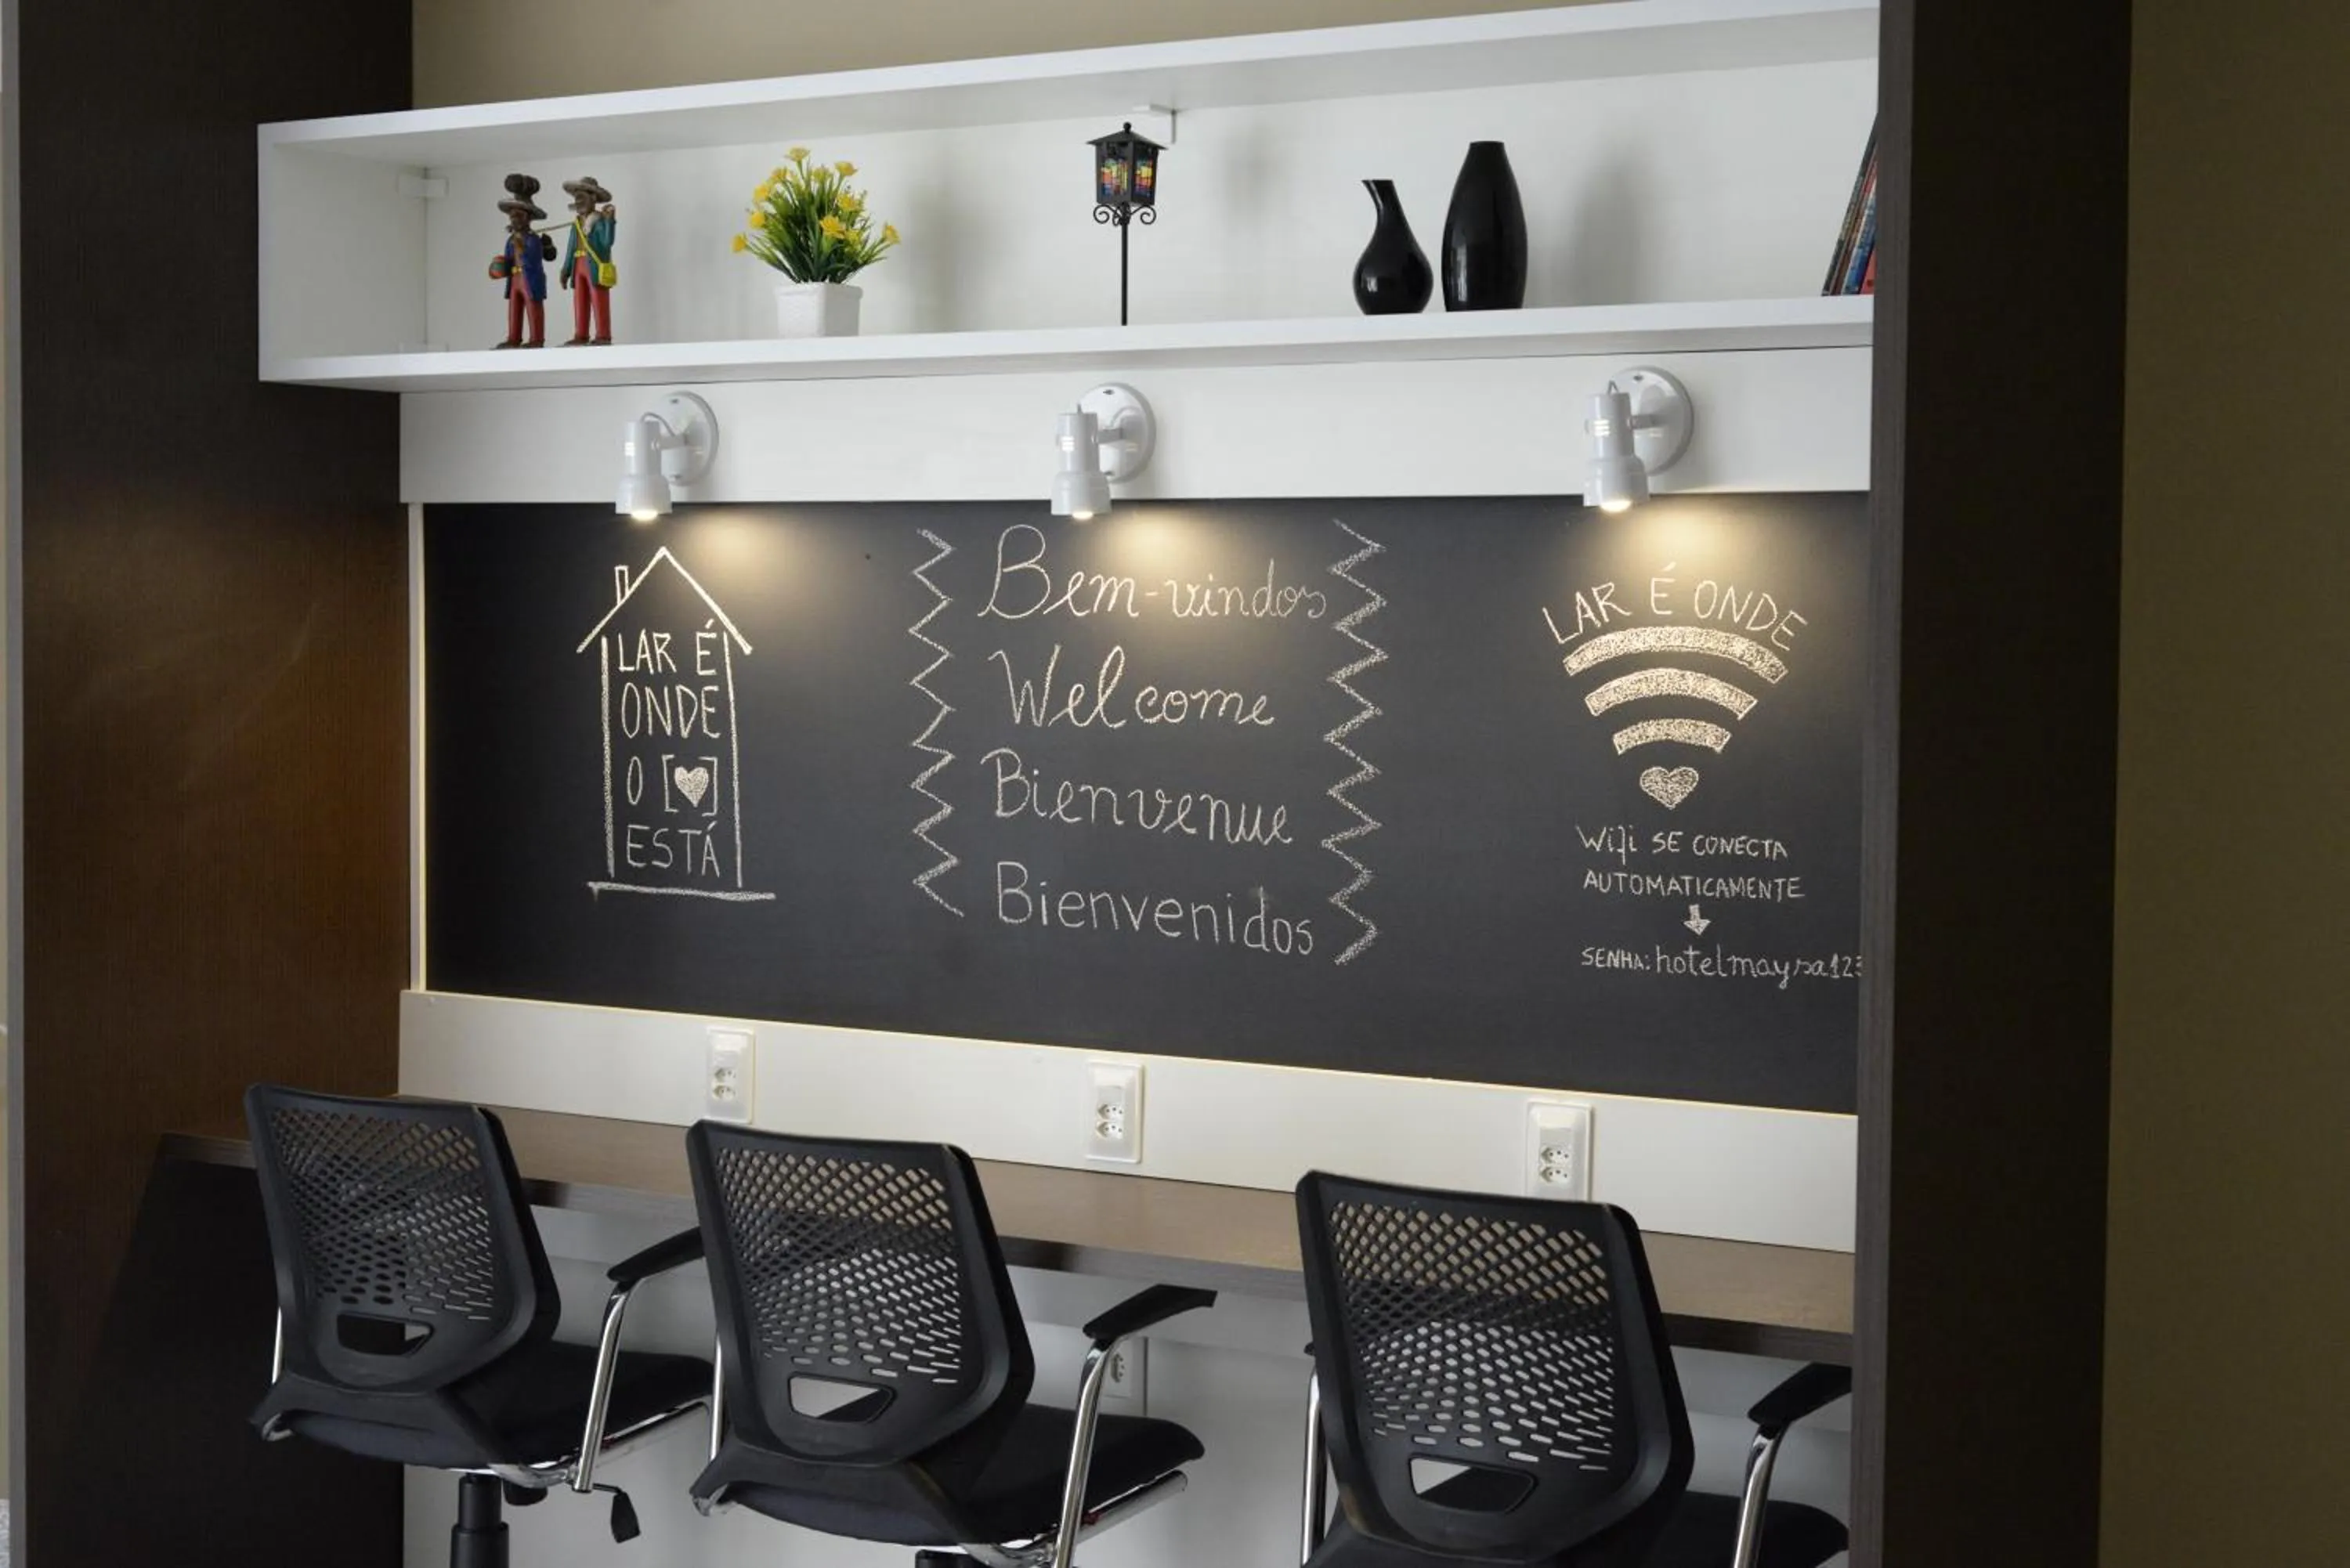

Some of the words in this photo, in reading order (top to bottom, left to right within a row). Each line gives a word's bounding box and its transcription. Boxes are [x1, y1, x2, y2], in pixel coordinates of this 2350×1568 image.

[977, 524, 1327, 619] Bem-vindos
[1542, 582, 1632, 645] LAR
[1650, 561, 1676, 615] É
[1694, 580, 1809, 652] ONDE
[618, 628, 677, 674] LAR
[696, 618, 717, 676] É
[621, 682, 721, 739] ONDE
[987, 643, 1274, 728] Welcome
[627, 756, 643, 805] O
[980, 748, 1293, 844] Bienvenue
[627, 821, 720, 877] ESTÁ
[1652, 831, 1684, 854] SE
[1692, 834, 1788, 861] CONECTA
[996, 861, 1314, 954] Bienvenidos
[1582, 869, 1805, 902] AUTOMATICAMENTE
